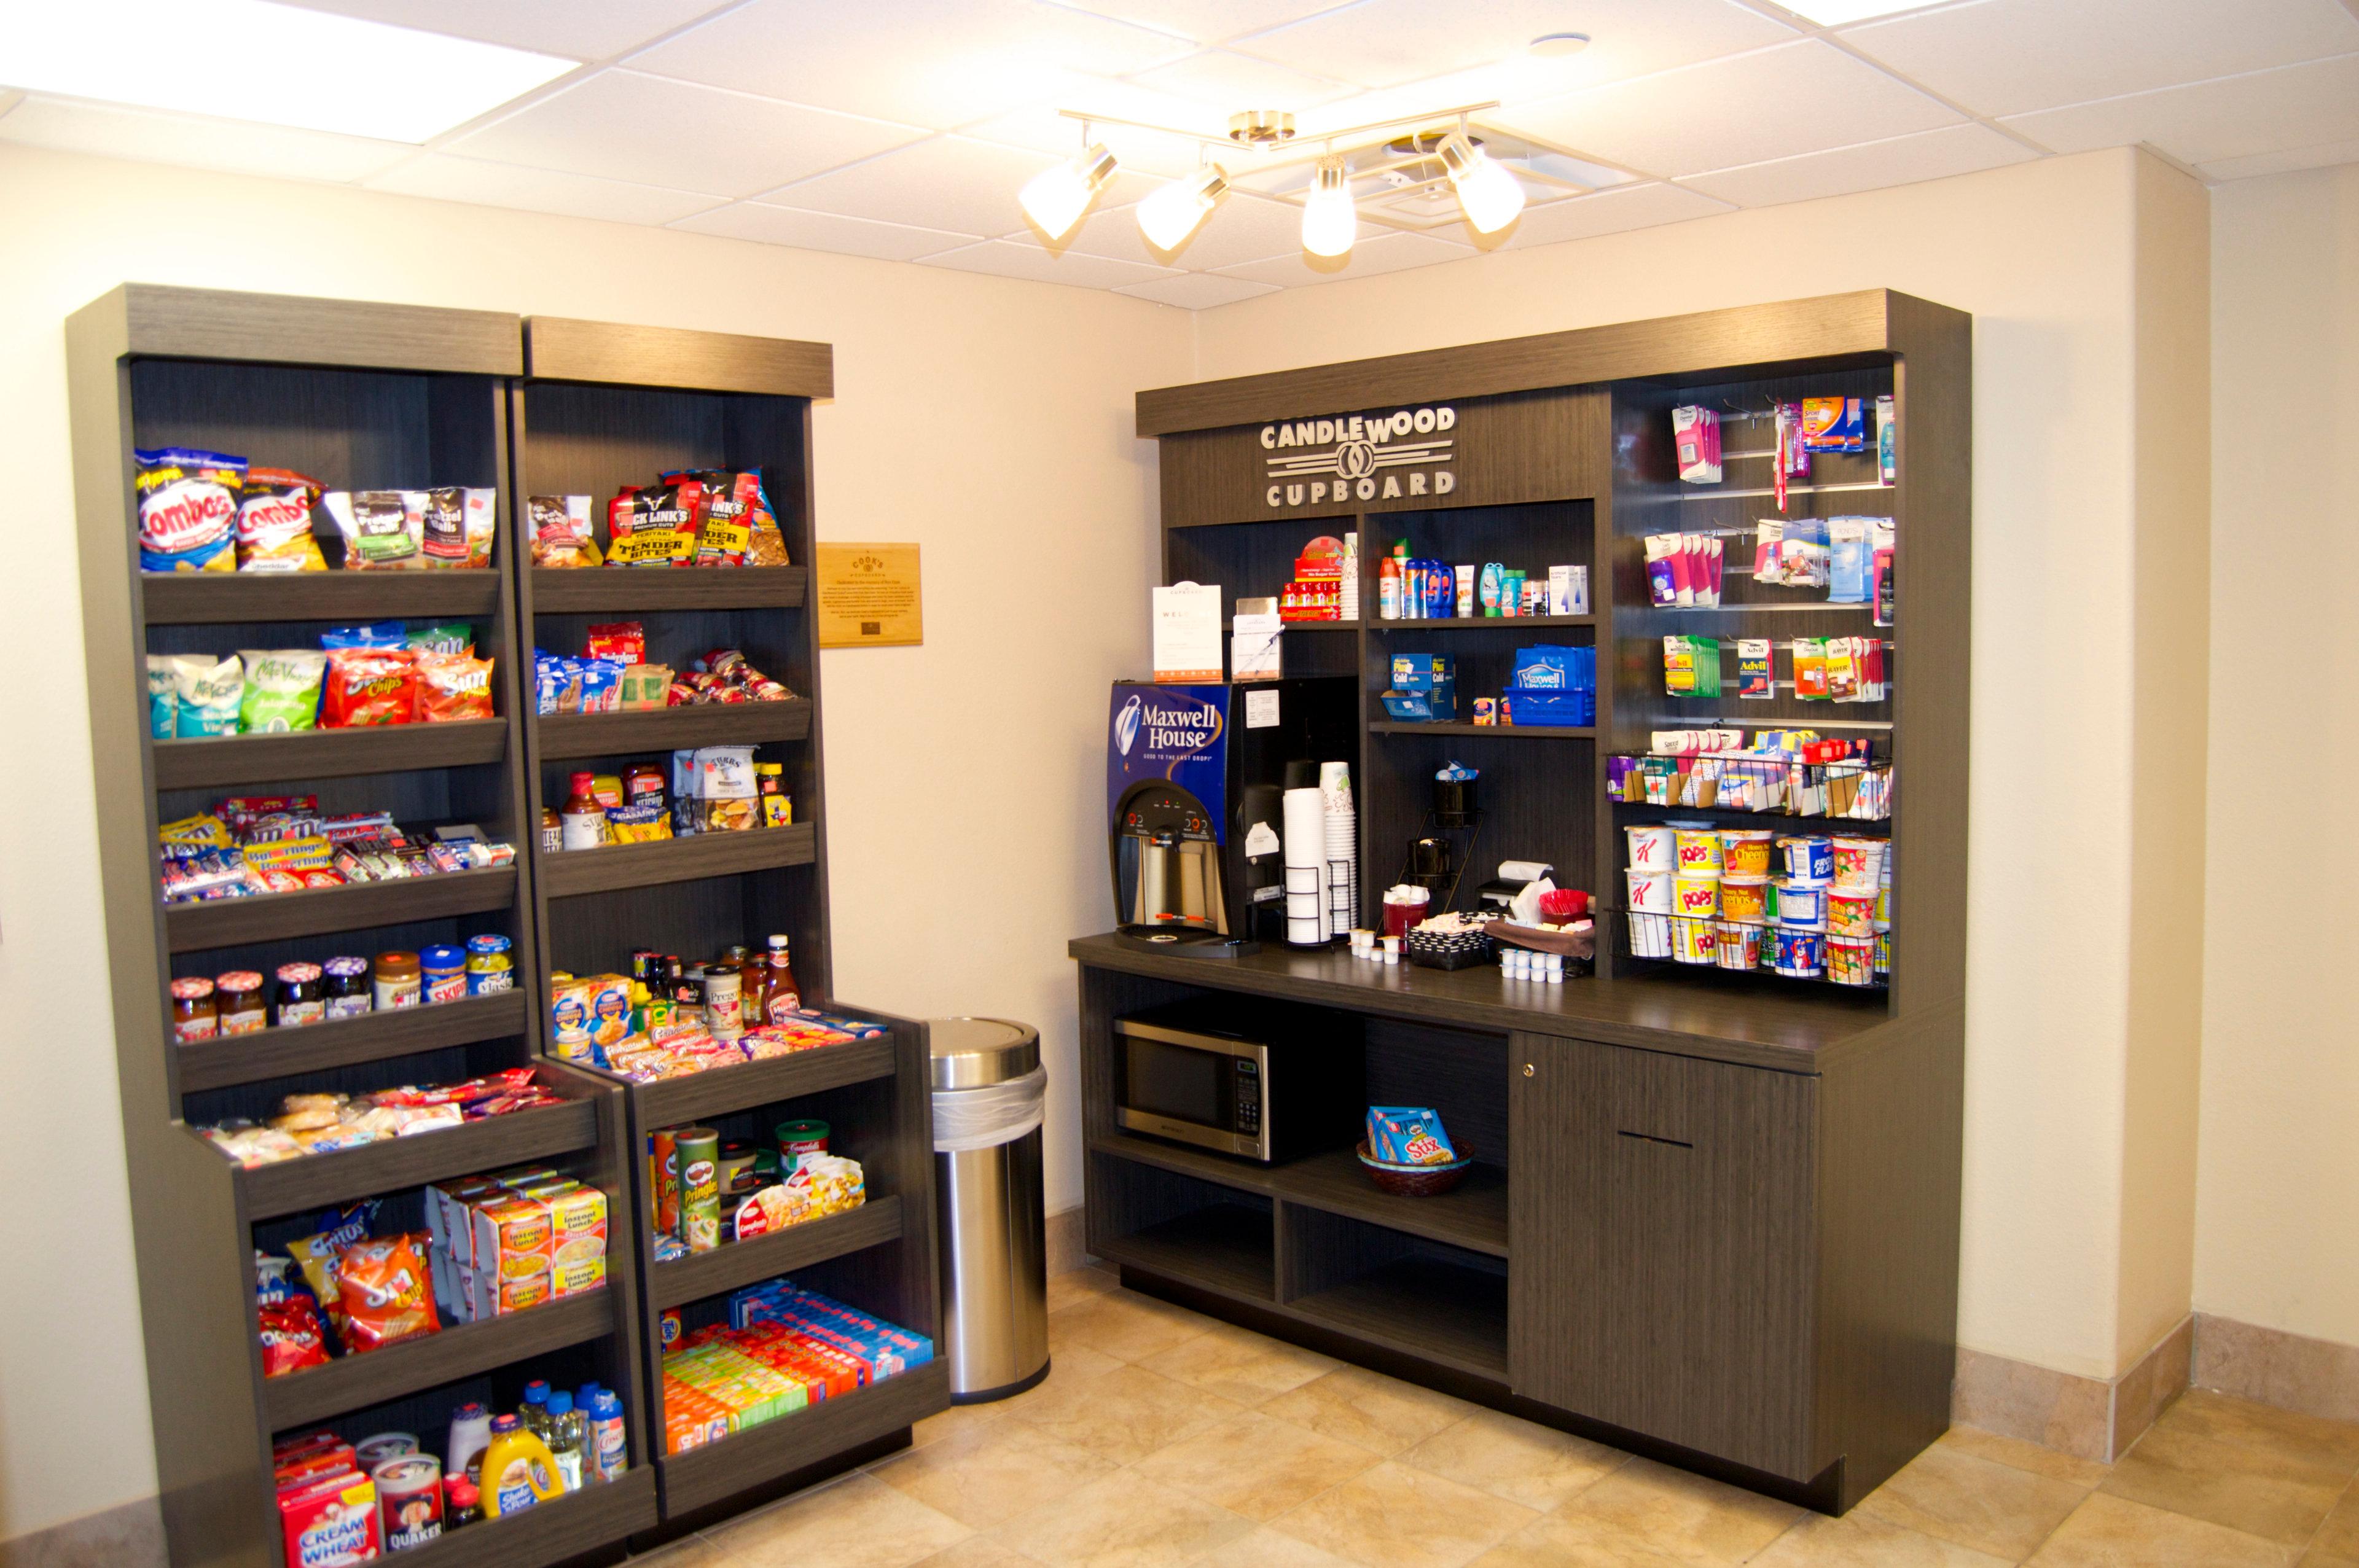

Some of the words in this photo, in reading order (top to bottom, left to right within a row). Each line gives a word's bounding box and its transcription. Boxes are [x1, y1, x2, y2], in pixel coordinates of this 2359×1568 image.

[1261, 407, 1455, 449] CANDLEWOOD
[1267, 471, 1455, 507] CUPBOARD
[238, 495, 309, 535] Combo
[711, 501, 745, 515] INK'S
[650, 509, 689, 523] LINK'S
[705, 531, 738, 544] DER
[619, 540, 683, 555] TENDER
[630, 548, 671, 559] BITES
[853, 556, 883, 569] COOK'S
[1433, 662, 1444, 672] Plus
[1740, 661, 1766, 670] Advil
[1828, 665, 1848, 673] BAYER
[442, 671, 488, 697] Sun
[1393, 673, 1407, 683] Cold
[1433, 673, 1444, 683] Cold
[1522, 673, 1560, 684] Maxwell
[369, 678, 403, 697] Chips
[1142, 704, 1215, 728] Maxwell
[1149, 728, 1206, 749] House
[1637, 838, 1657, 863] K
[1633, 881, 1652, 906] K
[710, 991, 738, 1004] Prego
[1406, 1139, 1441, 1158] Stix
[685, 1180, 718, 1207] Pringles
[564, 1211, 597, 1223] Instant
[567, 1219, 593, 1229] Lunch
[509, 1228, 544, 1241] Instant
[514, 1236, 540, 1247] Lunch
[565, 1270, 596, 1282] Instant
[568, 1277, 593, 1288] Lunch
[509, 1286, 541, 1300] Instant
[514, 1295, 539, 1305] Lunch
[662, 1319, 675, 1341] Tide
[300, 1517, 366, 1548] CREAM
[391, 1522, 442, 1549] QUAKER
[301, 1531, 367, 1564] WHEAT
